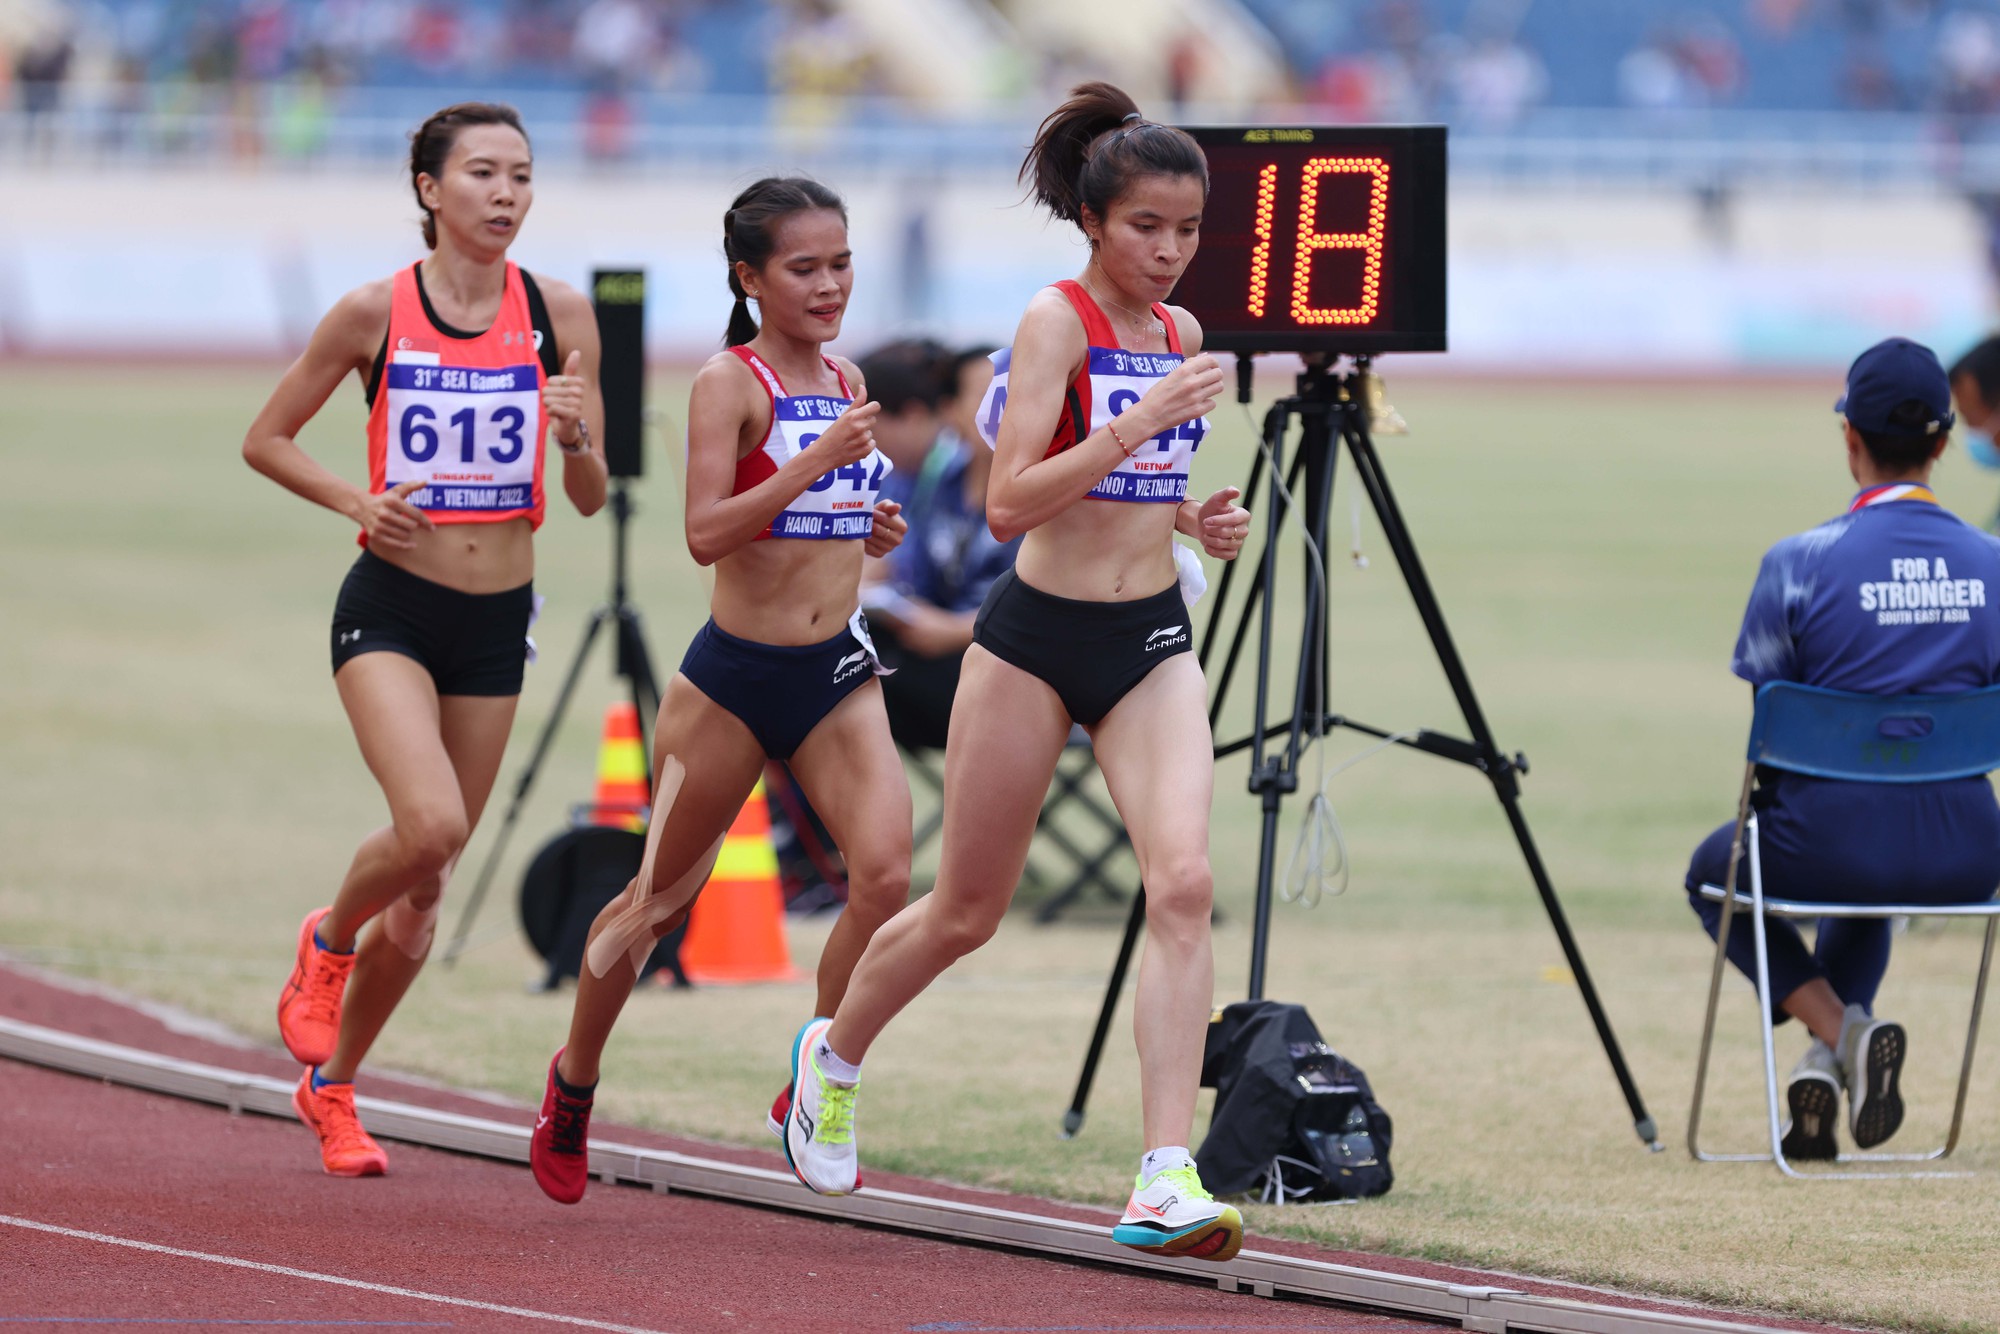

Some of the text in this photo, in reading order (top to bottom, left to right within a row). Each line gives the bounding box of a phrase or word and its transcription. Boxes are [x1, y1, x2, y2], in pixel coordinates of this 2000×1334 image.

[1247, 157, 1390, 325] 18
[1130, 356, 1154, 373] SEA
[1151, 357, 1183, 373] Game
[440, 369, 468, 390] SEA
[469, 371, 516, 391] Games
[815, 399, 836, 417] SEA
[400, 404, 526, 464] 613
[1134, 462, 1173, 471] VIETNAM
[1092, 476, 1126, 495] ANOI
[1135, 478, 1175, 497] VIETNAM
[443, 487, 498, 507] VIETNAM
[498, 487, 525, 506] 2022
[832, 501, 864, 510] VIETNAM
[784, 515, 823, 535] HANOI
[832, 516, 865, 535] VIETNAM
[1892, 556, 1949, 581] FOR A
[1859, 578, 1986, 612] STRONGER
[1877, 607, 1971, 626] SOUTH EAST ASIA
[1145, 634, 1187, 651] LI-NING
